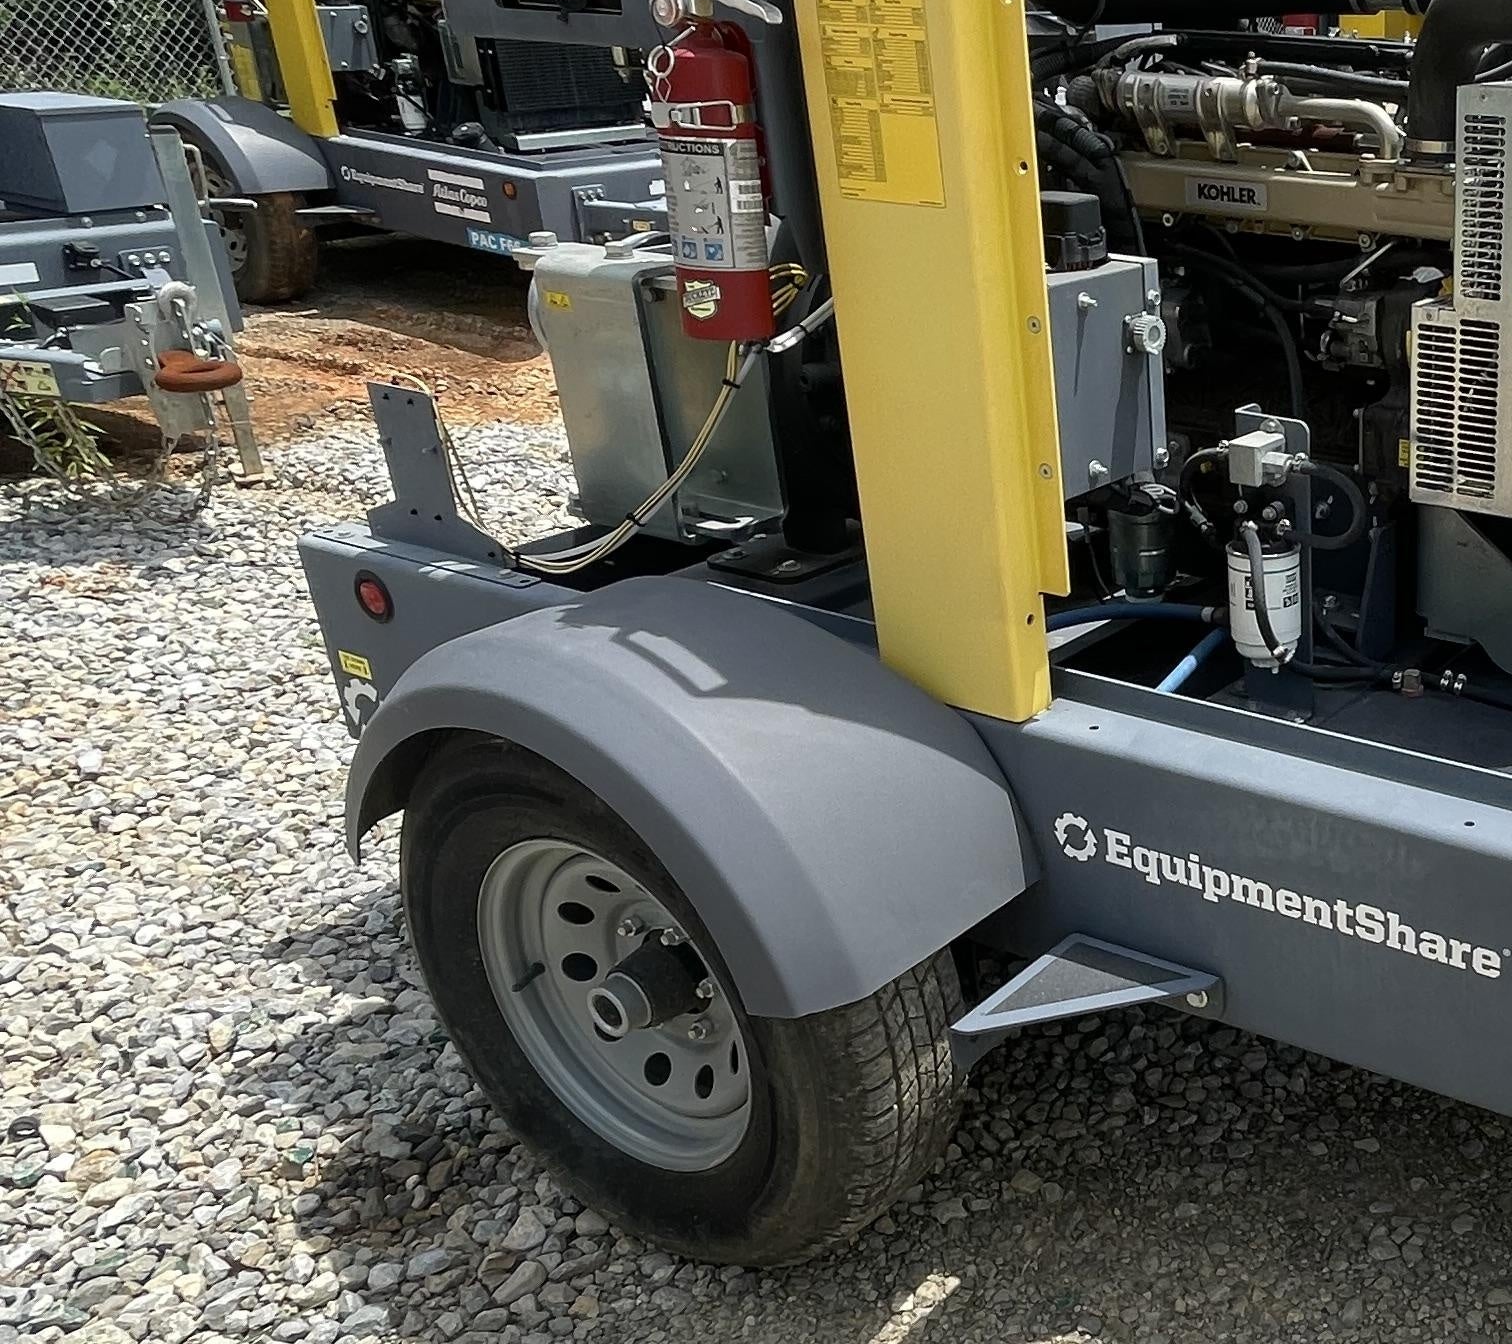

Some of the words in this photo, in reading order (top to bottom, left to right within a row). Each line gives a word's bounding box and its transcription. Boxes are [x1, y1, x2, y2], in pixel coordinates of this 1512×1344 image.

[432, 183, 460, 202] Atlas
[460, 187, 488, 208] Copco
[1197, 183, 1257, 205] KOHLER
[470, 231, 498, 250] PAC
[1103, 828, 1501, 979] EquipmentShare
